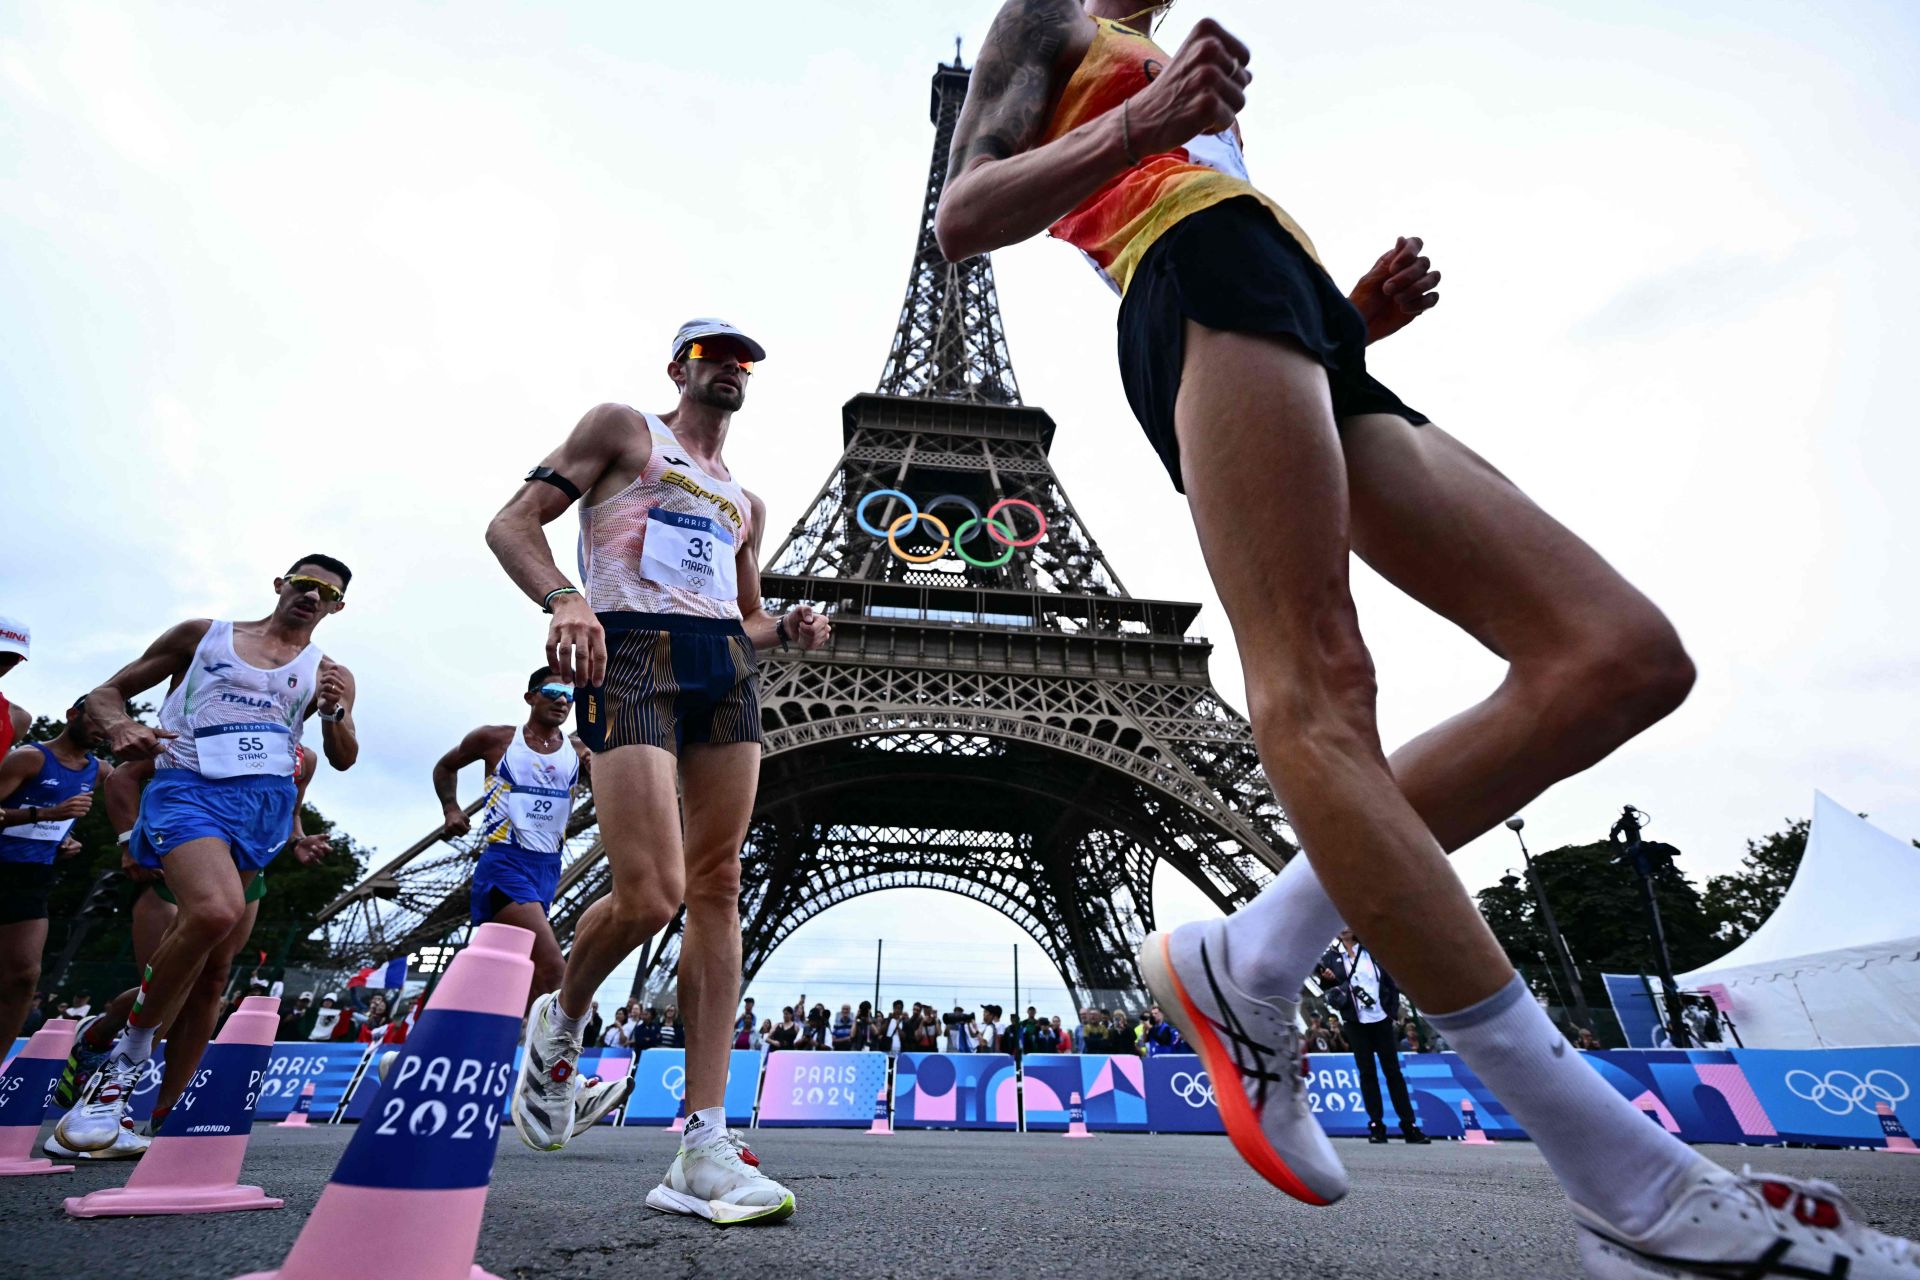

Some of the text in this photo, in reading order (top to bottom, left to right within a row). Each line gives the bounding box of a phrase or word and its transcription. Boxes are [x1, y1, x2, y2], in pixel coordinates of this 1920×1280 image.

[687, 537, 713, 562] 33
[681, 558, 715, 577] MARTIN
[0, 629, 26, 643] HINA
[221, 693, 272, 708] ITALIA
[588, 694, 597, 724] ESP
[238, 737, 264, 752] 55
[237, 752, 268, 761] STANO
[532, 799, 552, 813] 29
[526, 812, 554, 821] PINTADO
[791, 1087, 855, 1106] 2024
[1307, 1091, 1366, 1113] 202
[375, 1097, 499, 1140] 2024
[193, 1124, 231, 1133] MONDO
